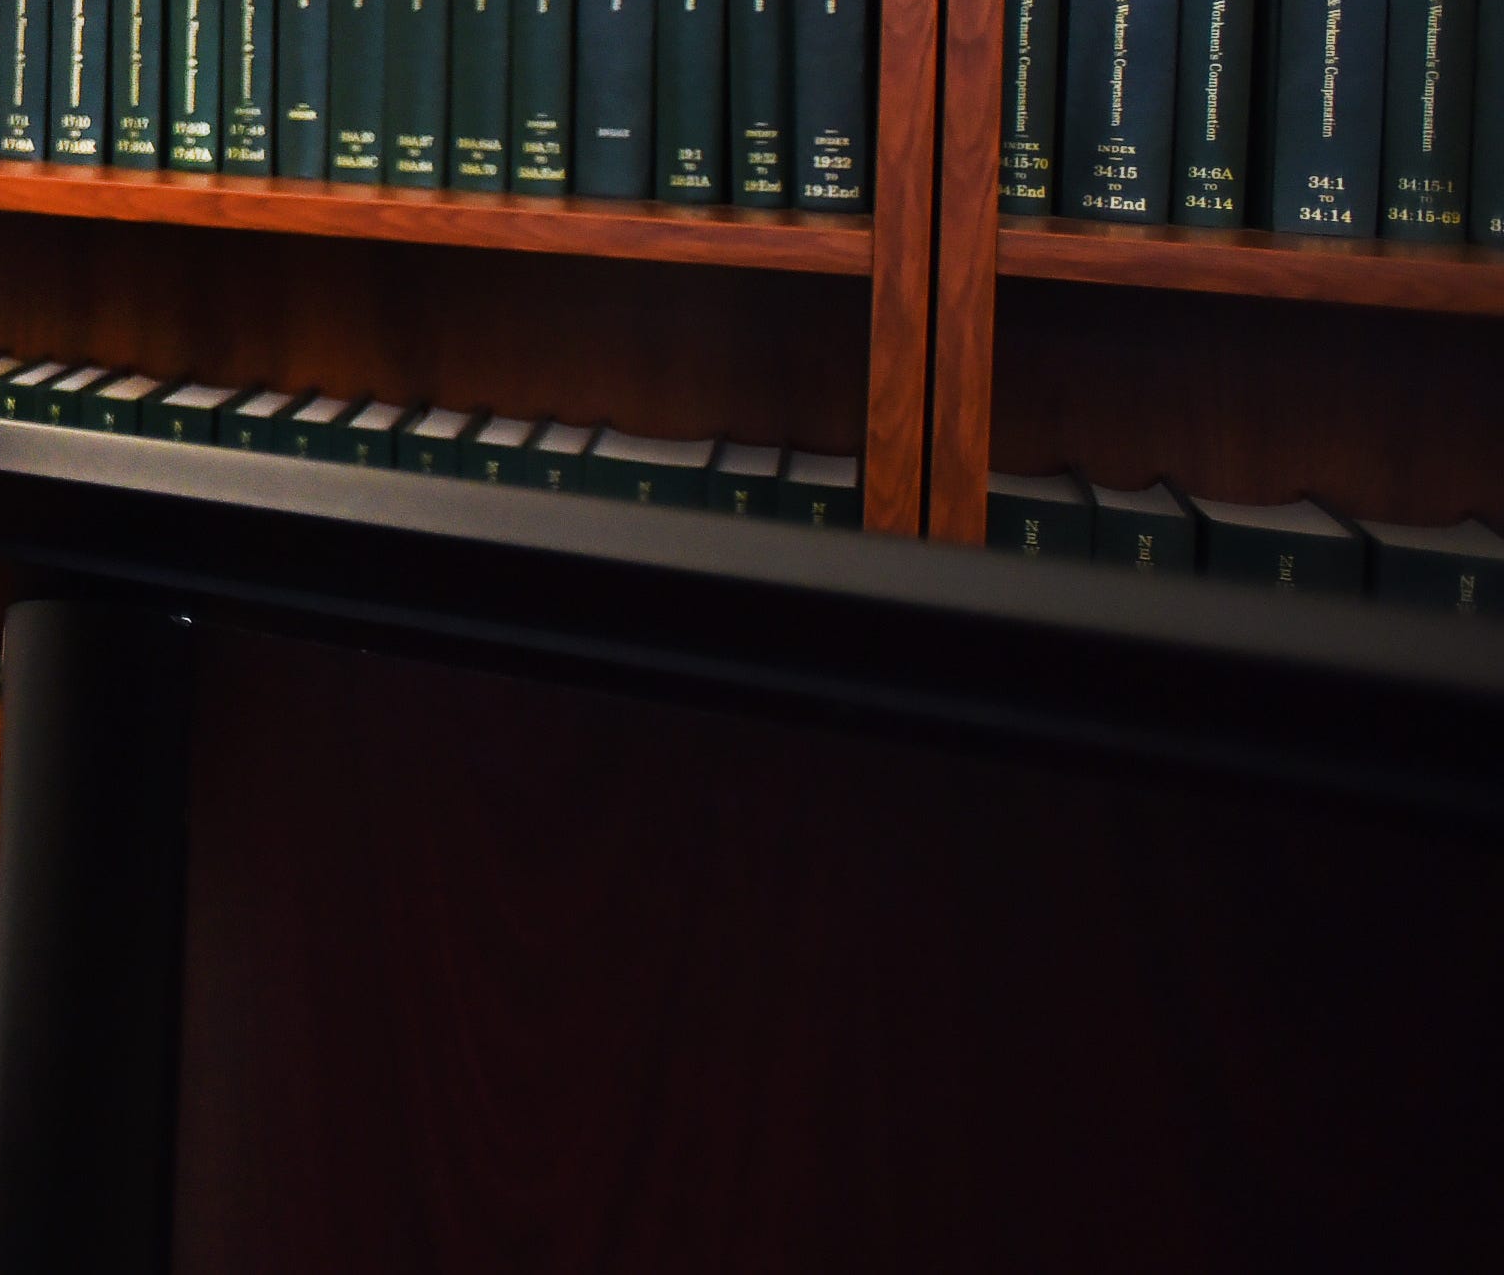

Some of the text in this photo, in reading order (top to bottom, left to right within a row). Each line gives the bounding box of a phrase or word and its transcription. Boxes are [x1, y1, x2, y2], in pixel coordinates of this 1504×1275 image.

[1109, 58, 1128, 126] Compensation
[1205, 63, 1223, 141] Compensation
[1320, 67, 1339, 138] Compensation
[1420, 70, 1441, 153] Compensation
[1097, 144, 1137, 155] INDEX
[1000, 157, 1048, 169] 4:15-70
[1093, 165, 1138, 180] 34:15
[1188, 167, 1234, 181] 34:6A
[1107, 183, 1123, 191] TO
[1203, 183, 1218, 191] TO
[1308, 175, 1345, 190] 34:1
[1398, 178, 1454, 193] 34:15-1
[804, 184, 861, 199] 19:End
[1319, 194, 1334, 203] TO
[1082, 195, 1147, 211] 34:End
[1185, 195, 1234, 210] 34:14
[1299, 207, 1352, 223] 34:14
[1387, 207, 1461, 224] 34:15-69
